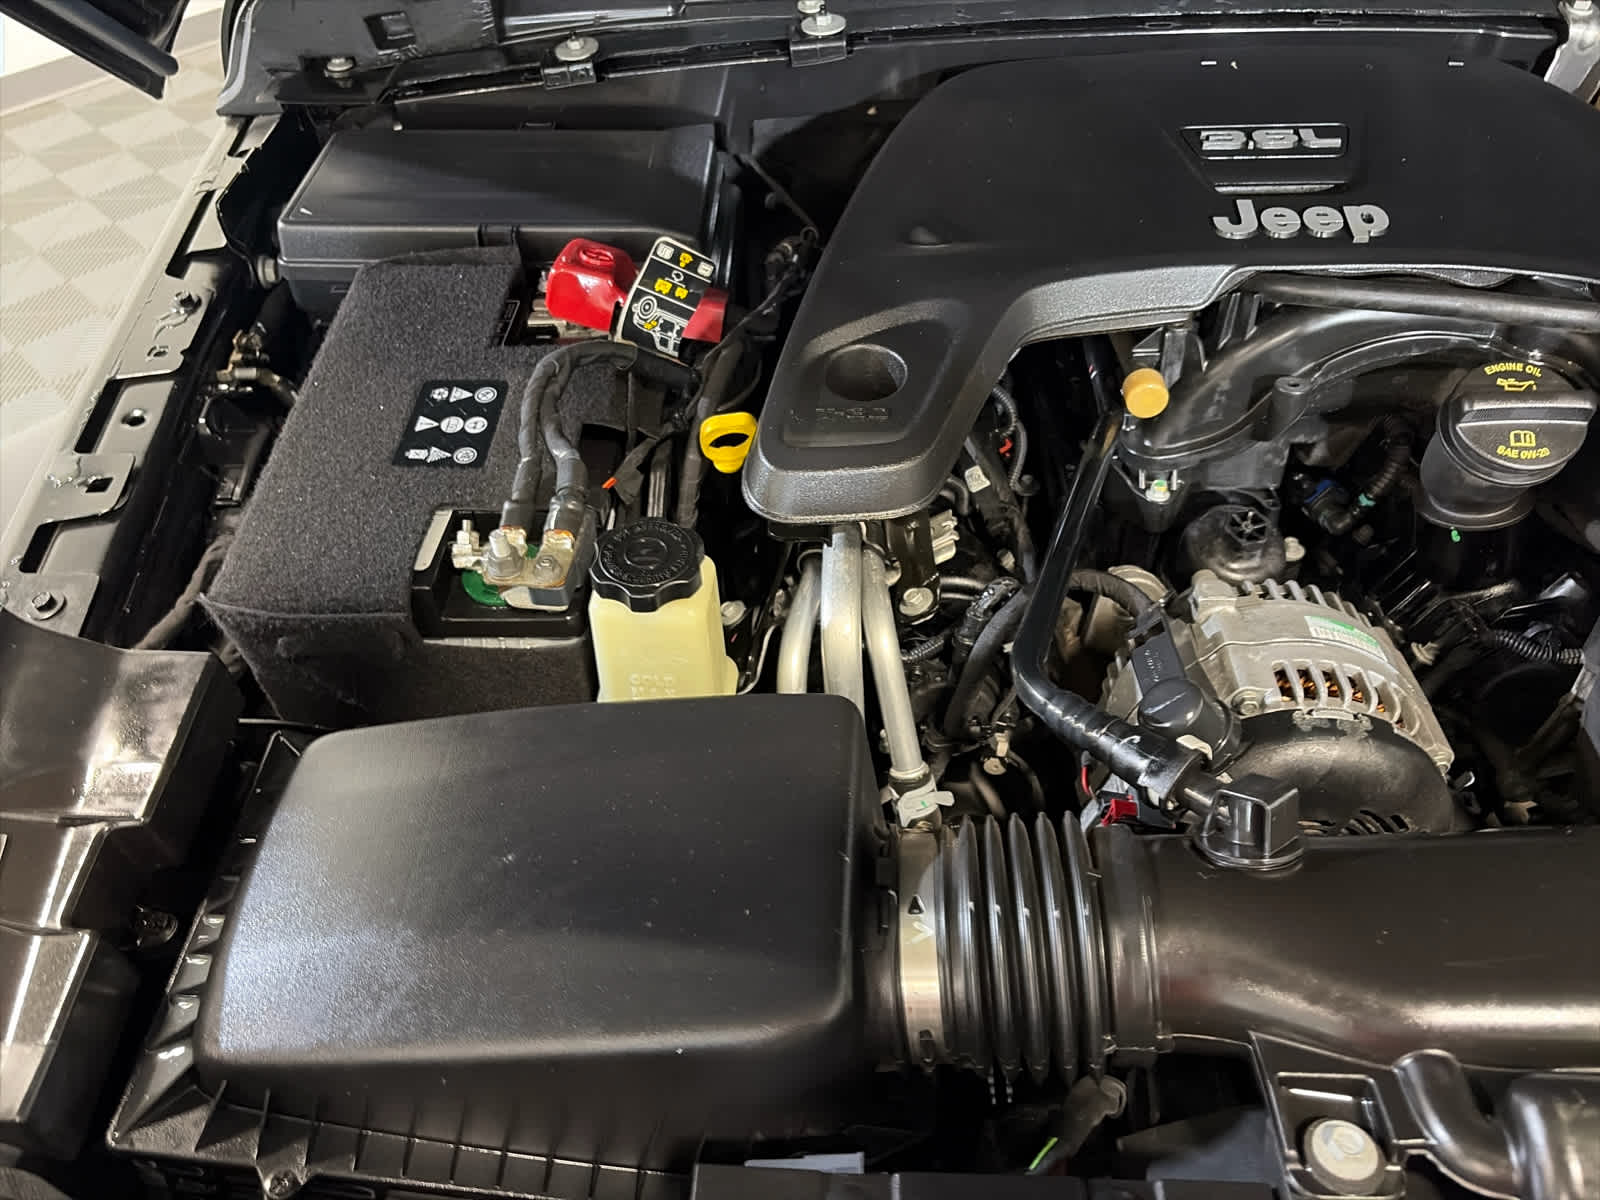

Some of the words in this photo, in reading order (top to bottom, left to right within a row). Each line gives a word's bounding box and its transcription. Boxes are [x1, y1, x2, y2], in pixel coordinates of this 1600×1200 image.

[1212, 199, 1390, 243] Jeep
[1484, 362, 1524, 376] ENGINE
[1525, 364, 1542, 377] OIL
